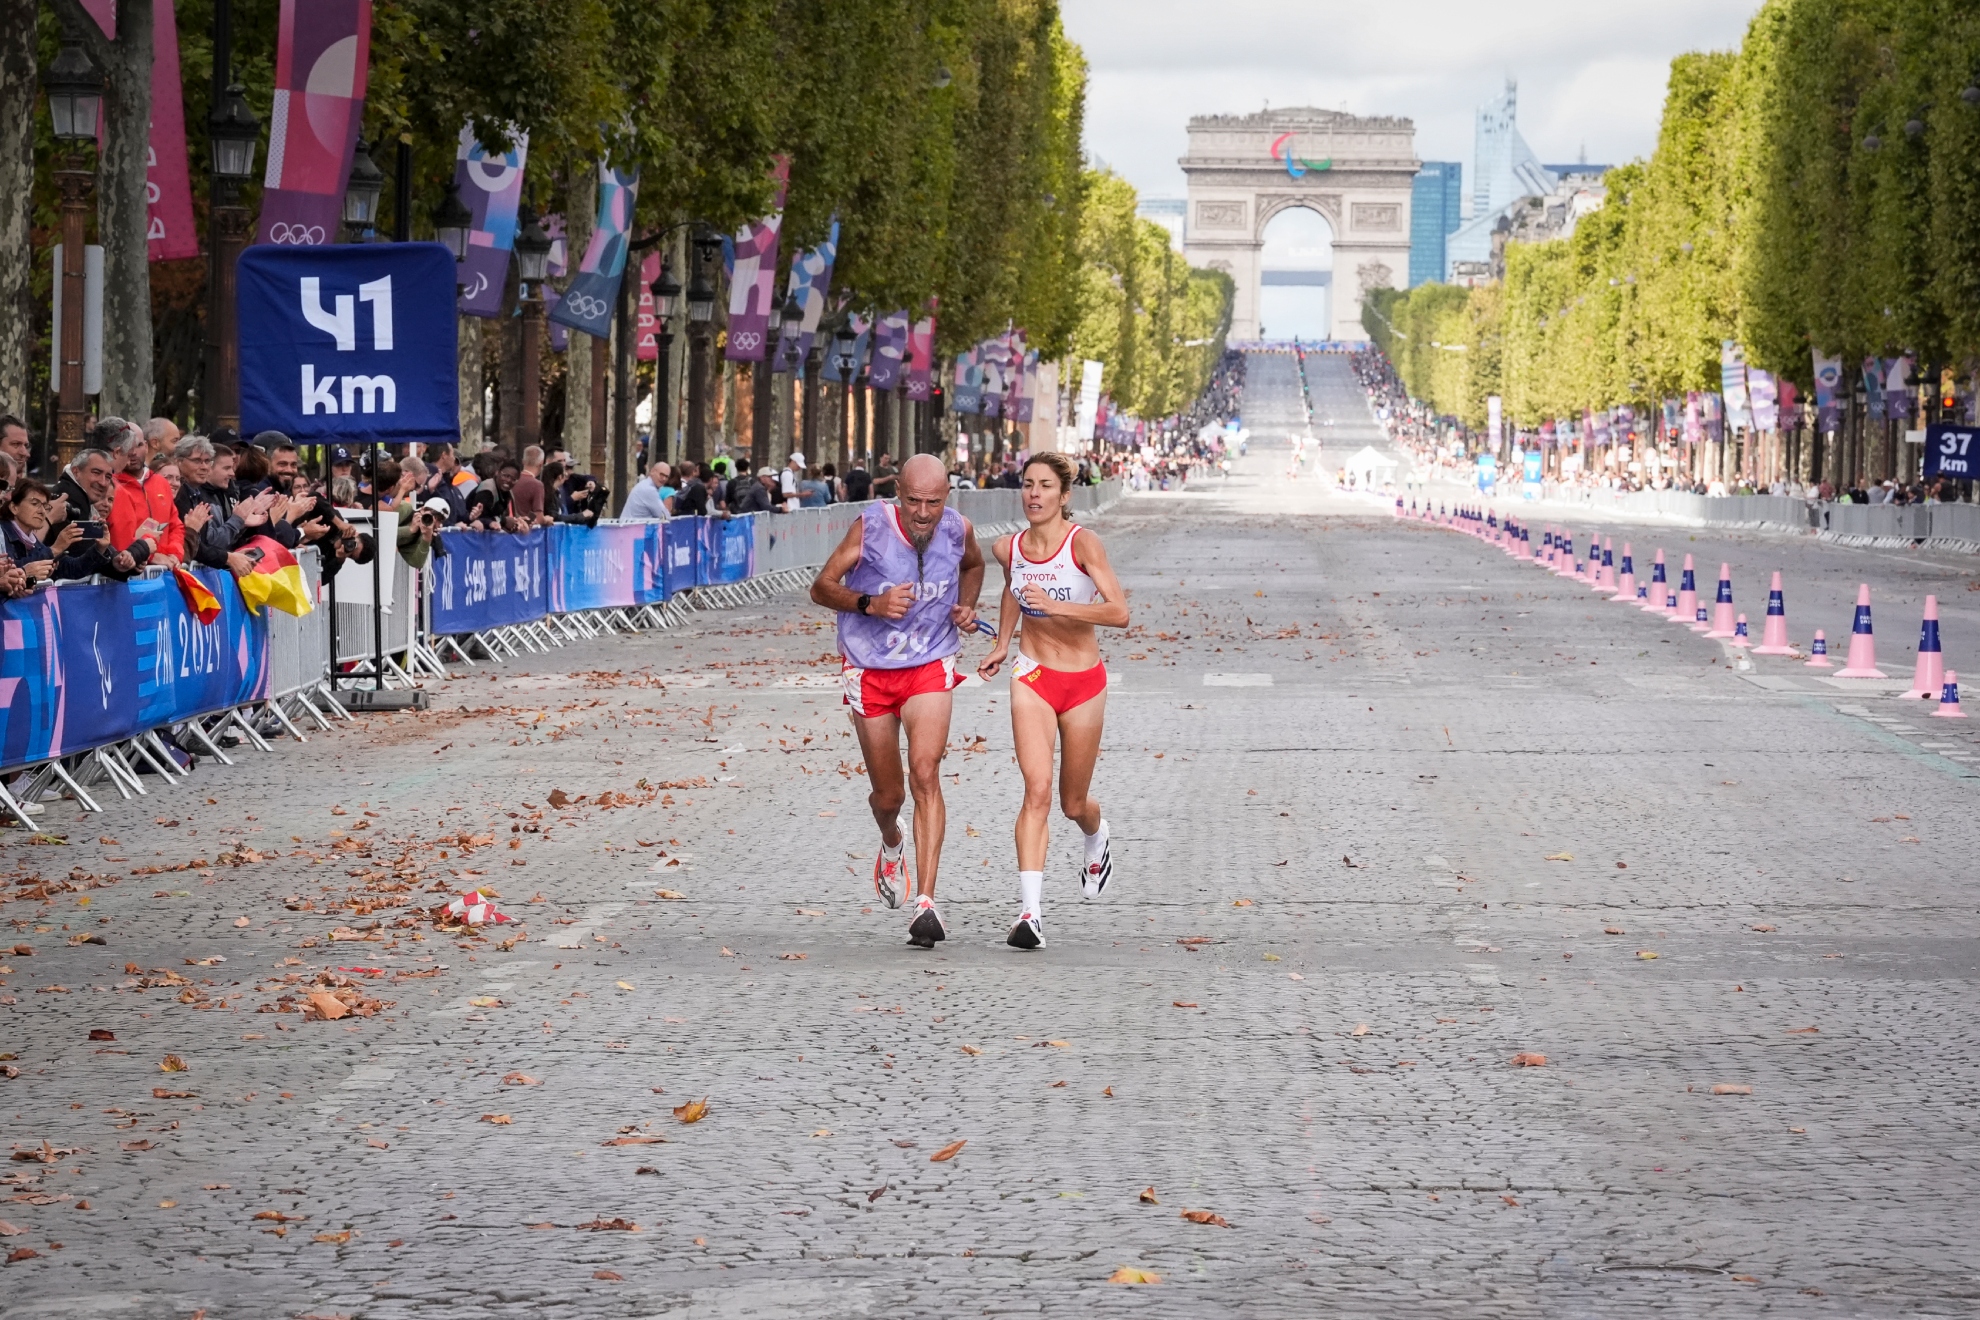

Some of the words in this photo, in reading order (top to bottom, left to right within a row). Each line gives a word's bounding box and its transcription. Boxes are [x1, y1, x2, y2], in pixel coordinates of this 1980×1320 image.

[300, 274, 393, 351] 41
[301, 364, 397, 415] km
[1939, 432, 1972, 456] 37
[1940, 455, 1968, 473] km
[1022, 573, 1057, 581] TOYOTA
[178, 612, 220, 677] 2024
[1027, 668, 1042, 683] ESP
